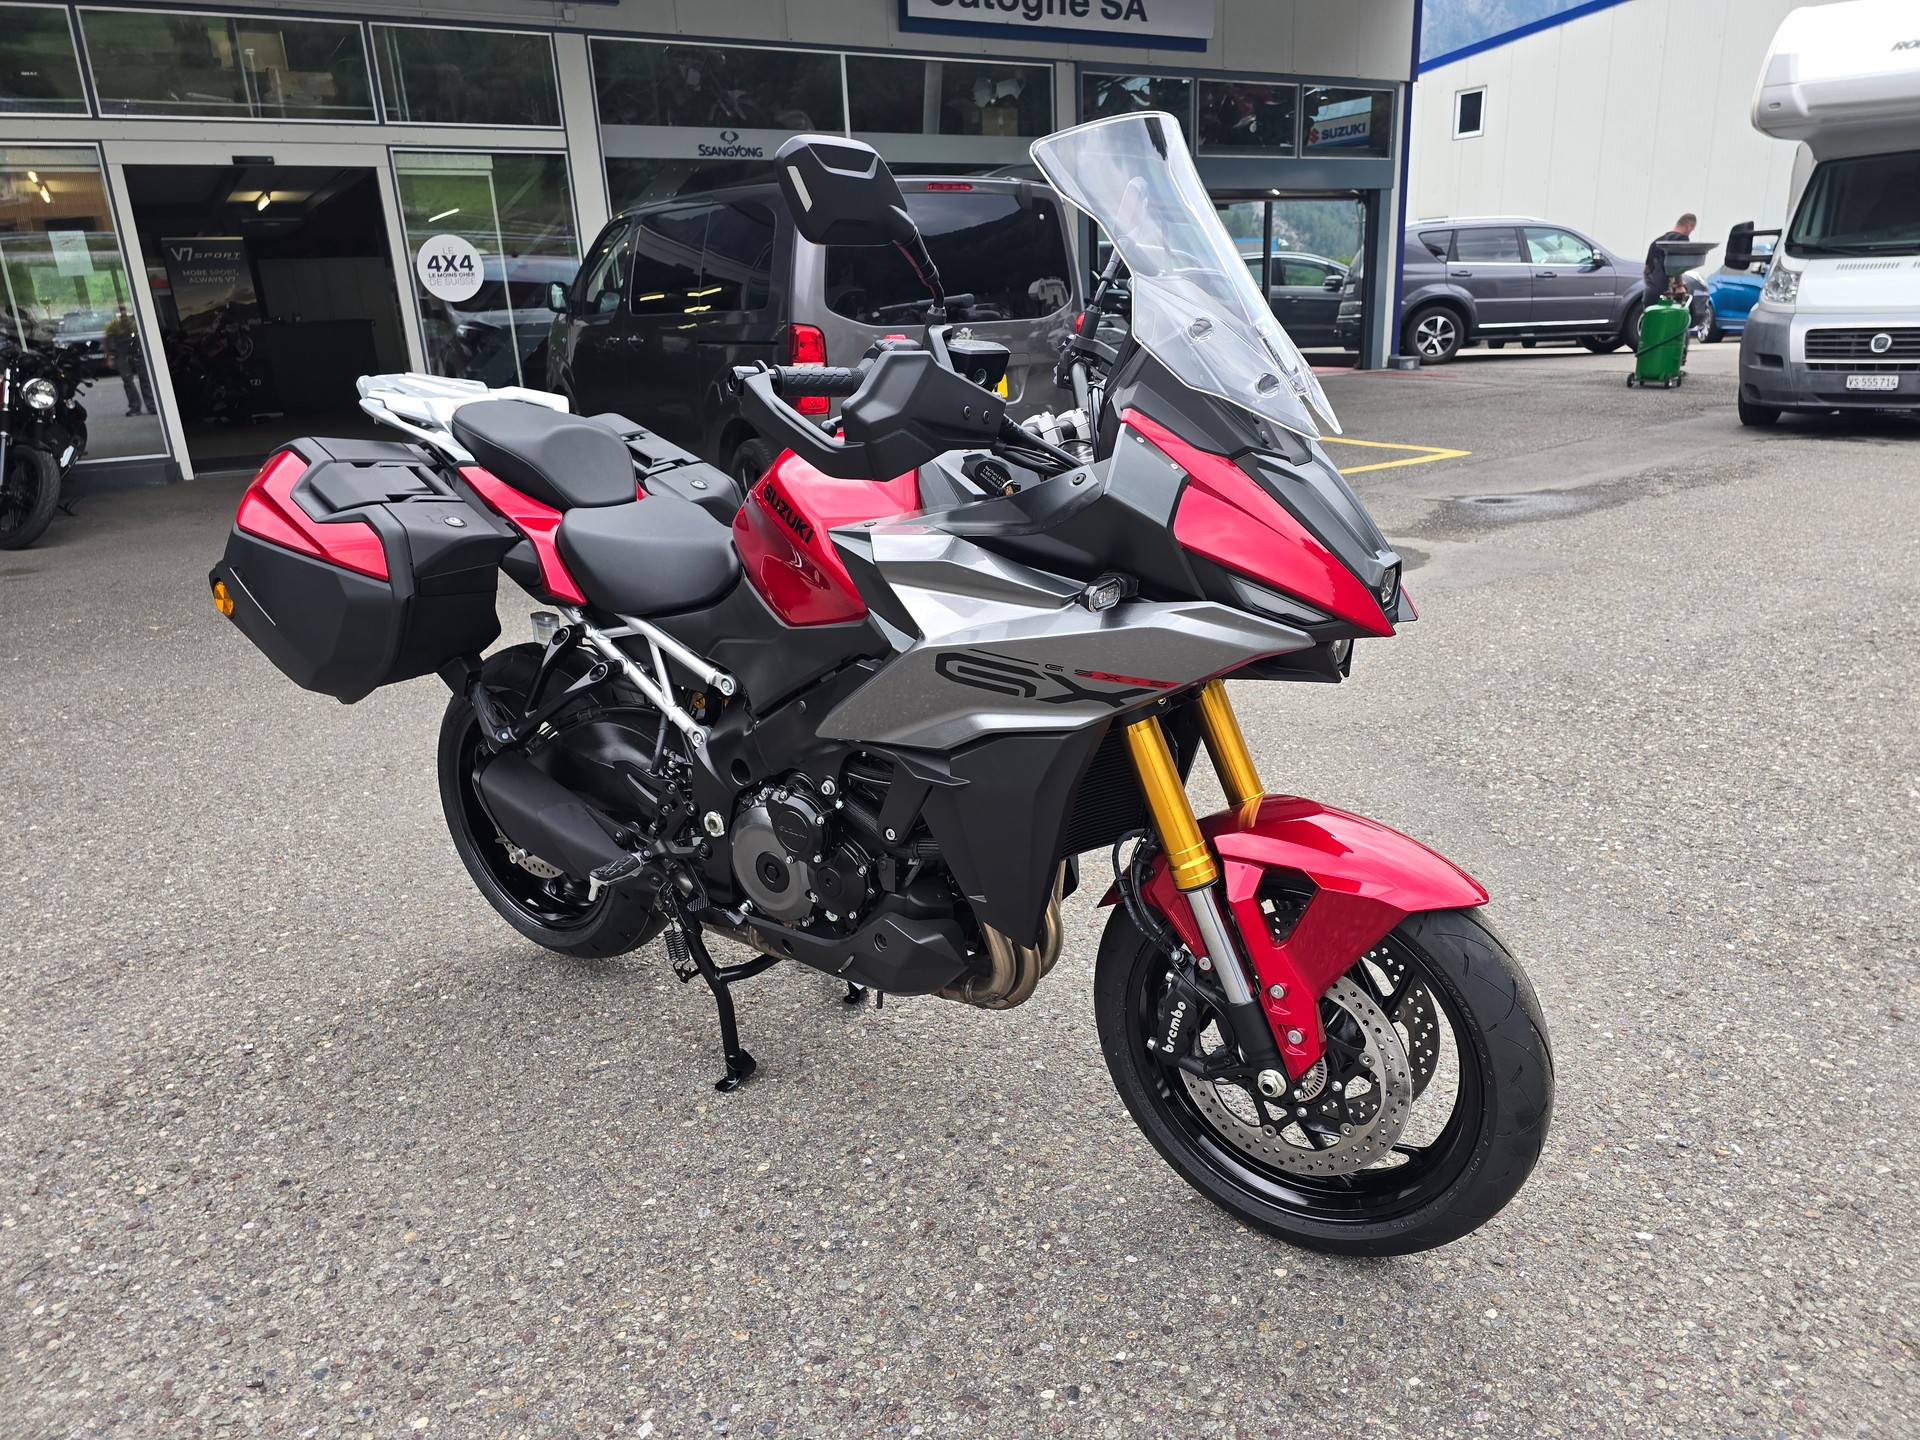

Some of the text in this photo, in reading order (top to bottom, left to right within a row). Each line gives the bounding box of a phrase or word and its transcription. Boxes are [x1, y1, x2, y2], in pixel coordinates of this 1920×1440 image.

[930, 0, 1148, 22] ogne SA
[1321, 122, 1366, 140] SUZUKI
[170, 247, 240, 262] V7 SPORT
[442, 246, 454, 255] LE
[427, 254, 474, 272] 4X4
[183, 268, 208, 276] MORE
[429, 278, 477, 286] DE SUISSE
[1849, 378, 1859, 387] VS
[1861, 378, 1878, 387] 555
[764, 483, 814, 544] SUZUKI
[1162, 1001, 1186, 1053] brembo
